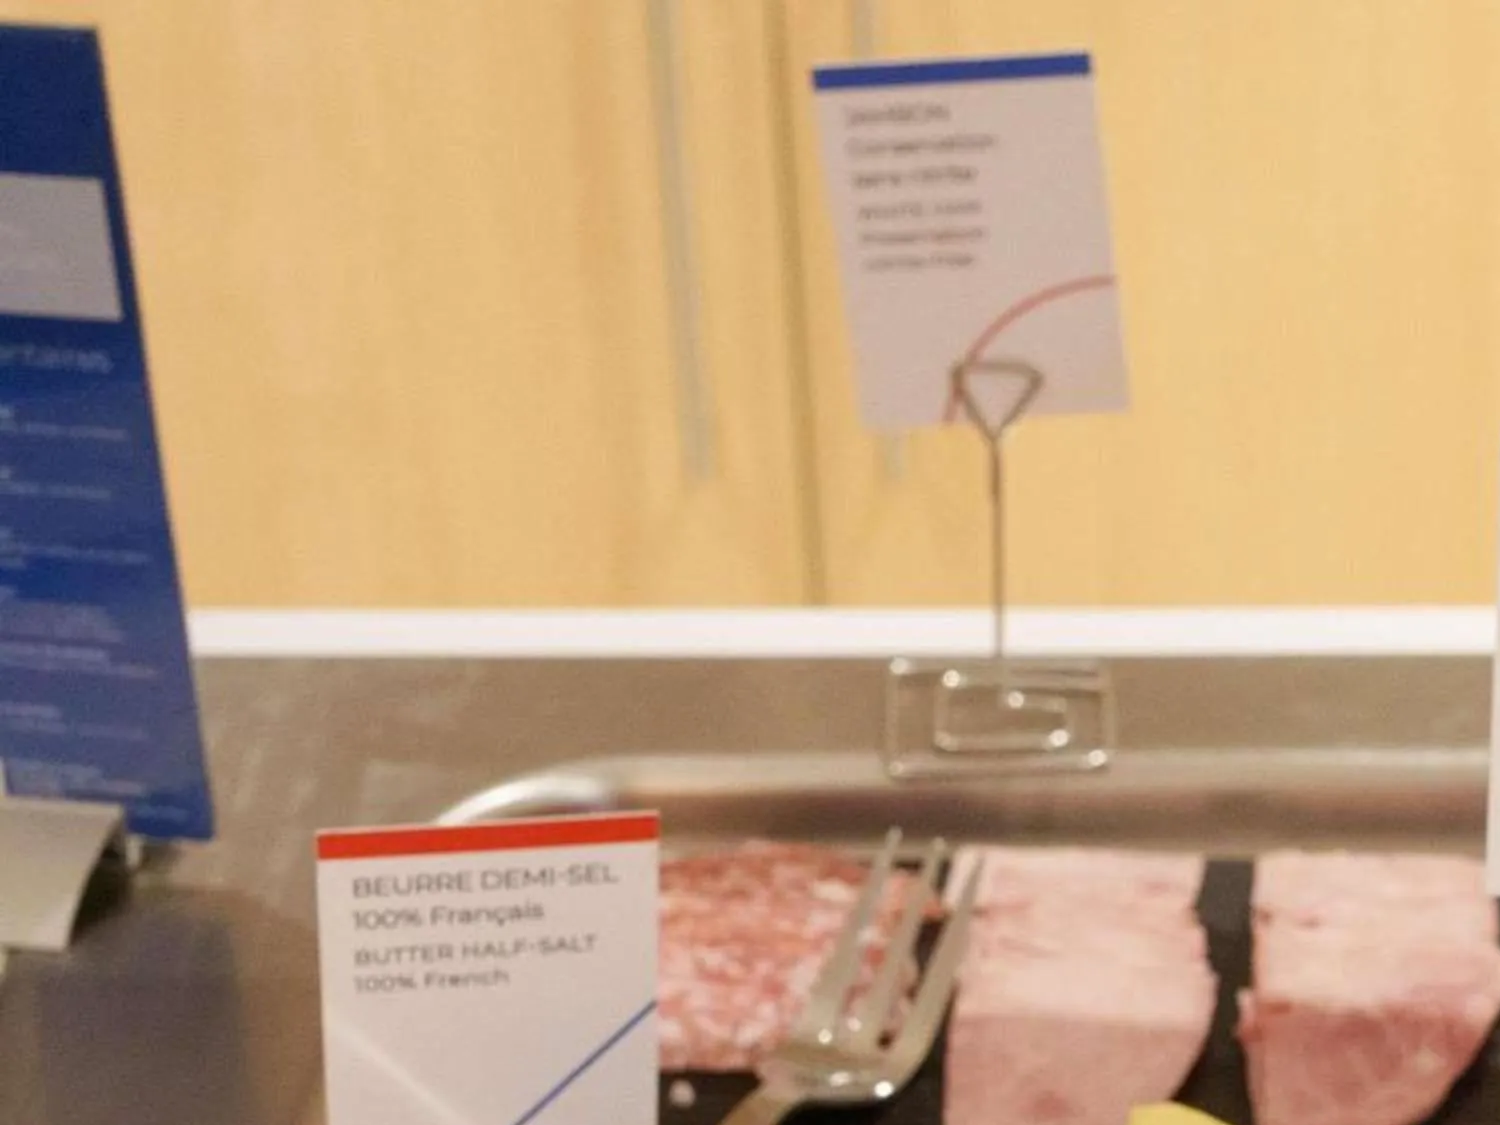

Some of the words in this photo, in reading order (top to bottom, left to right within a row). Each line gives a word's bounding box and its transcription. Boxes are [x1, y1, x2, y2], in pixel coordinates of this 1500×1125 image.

[352, 871, 473, 898] BEURRE
[480, 863, 620, 891] DEMI-SEL
[353, 908, 423, 931] 100%
[430, 899, 544, 927] Français
[354, 943, 454, 966] BUTTER
[461, 934, 597, 960] HALF-SALT
[353, 974, 417, 993] 100%
[424, 969, 510, 990] French
